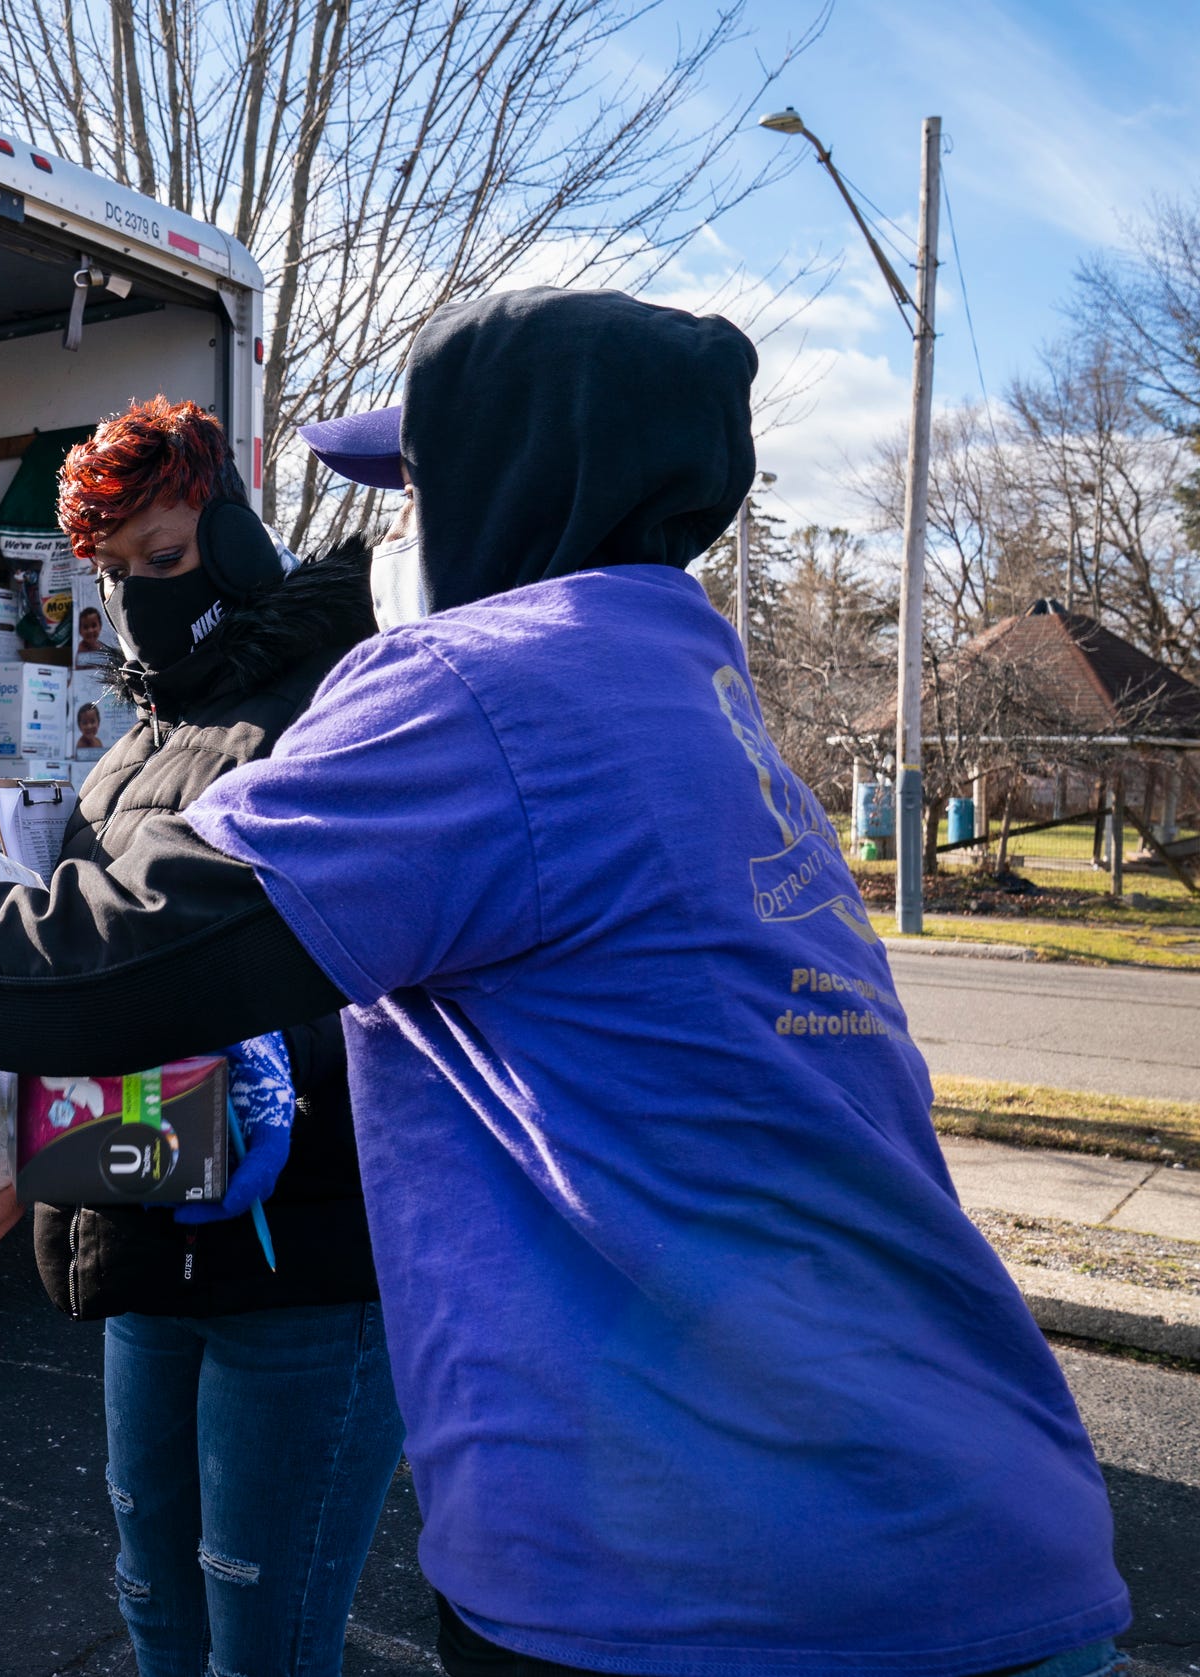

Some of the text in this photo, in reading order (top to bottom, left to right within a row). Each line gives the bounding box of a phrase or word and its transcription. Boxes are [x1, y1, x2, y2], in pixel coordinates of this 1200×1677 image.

[105, 201, 160, 239] DC 2379 G
[4, 540, 32, 550] We've
[35, 541, 52, 550] Got
[191, 600, 225, 644] NIKE
[759, 850, 823, 917] DETROIT
[791, 967, 853, 994] Place
[109, 1144, 142, 1174] U
[184, 1254, 193, 1280] GUESS
